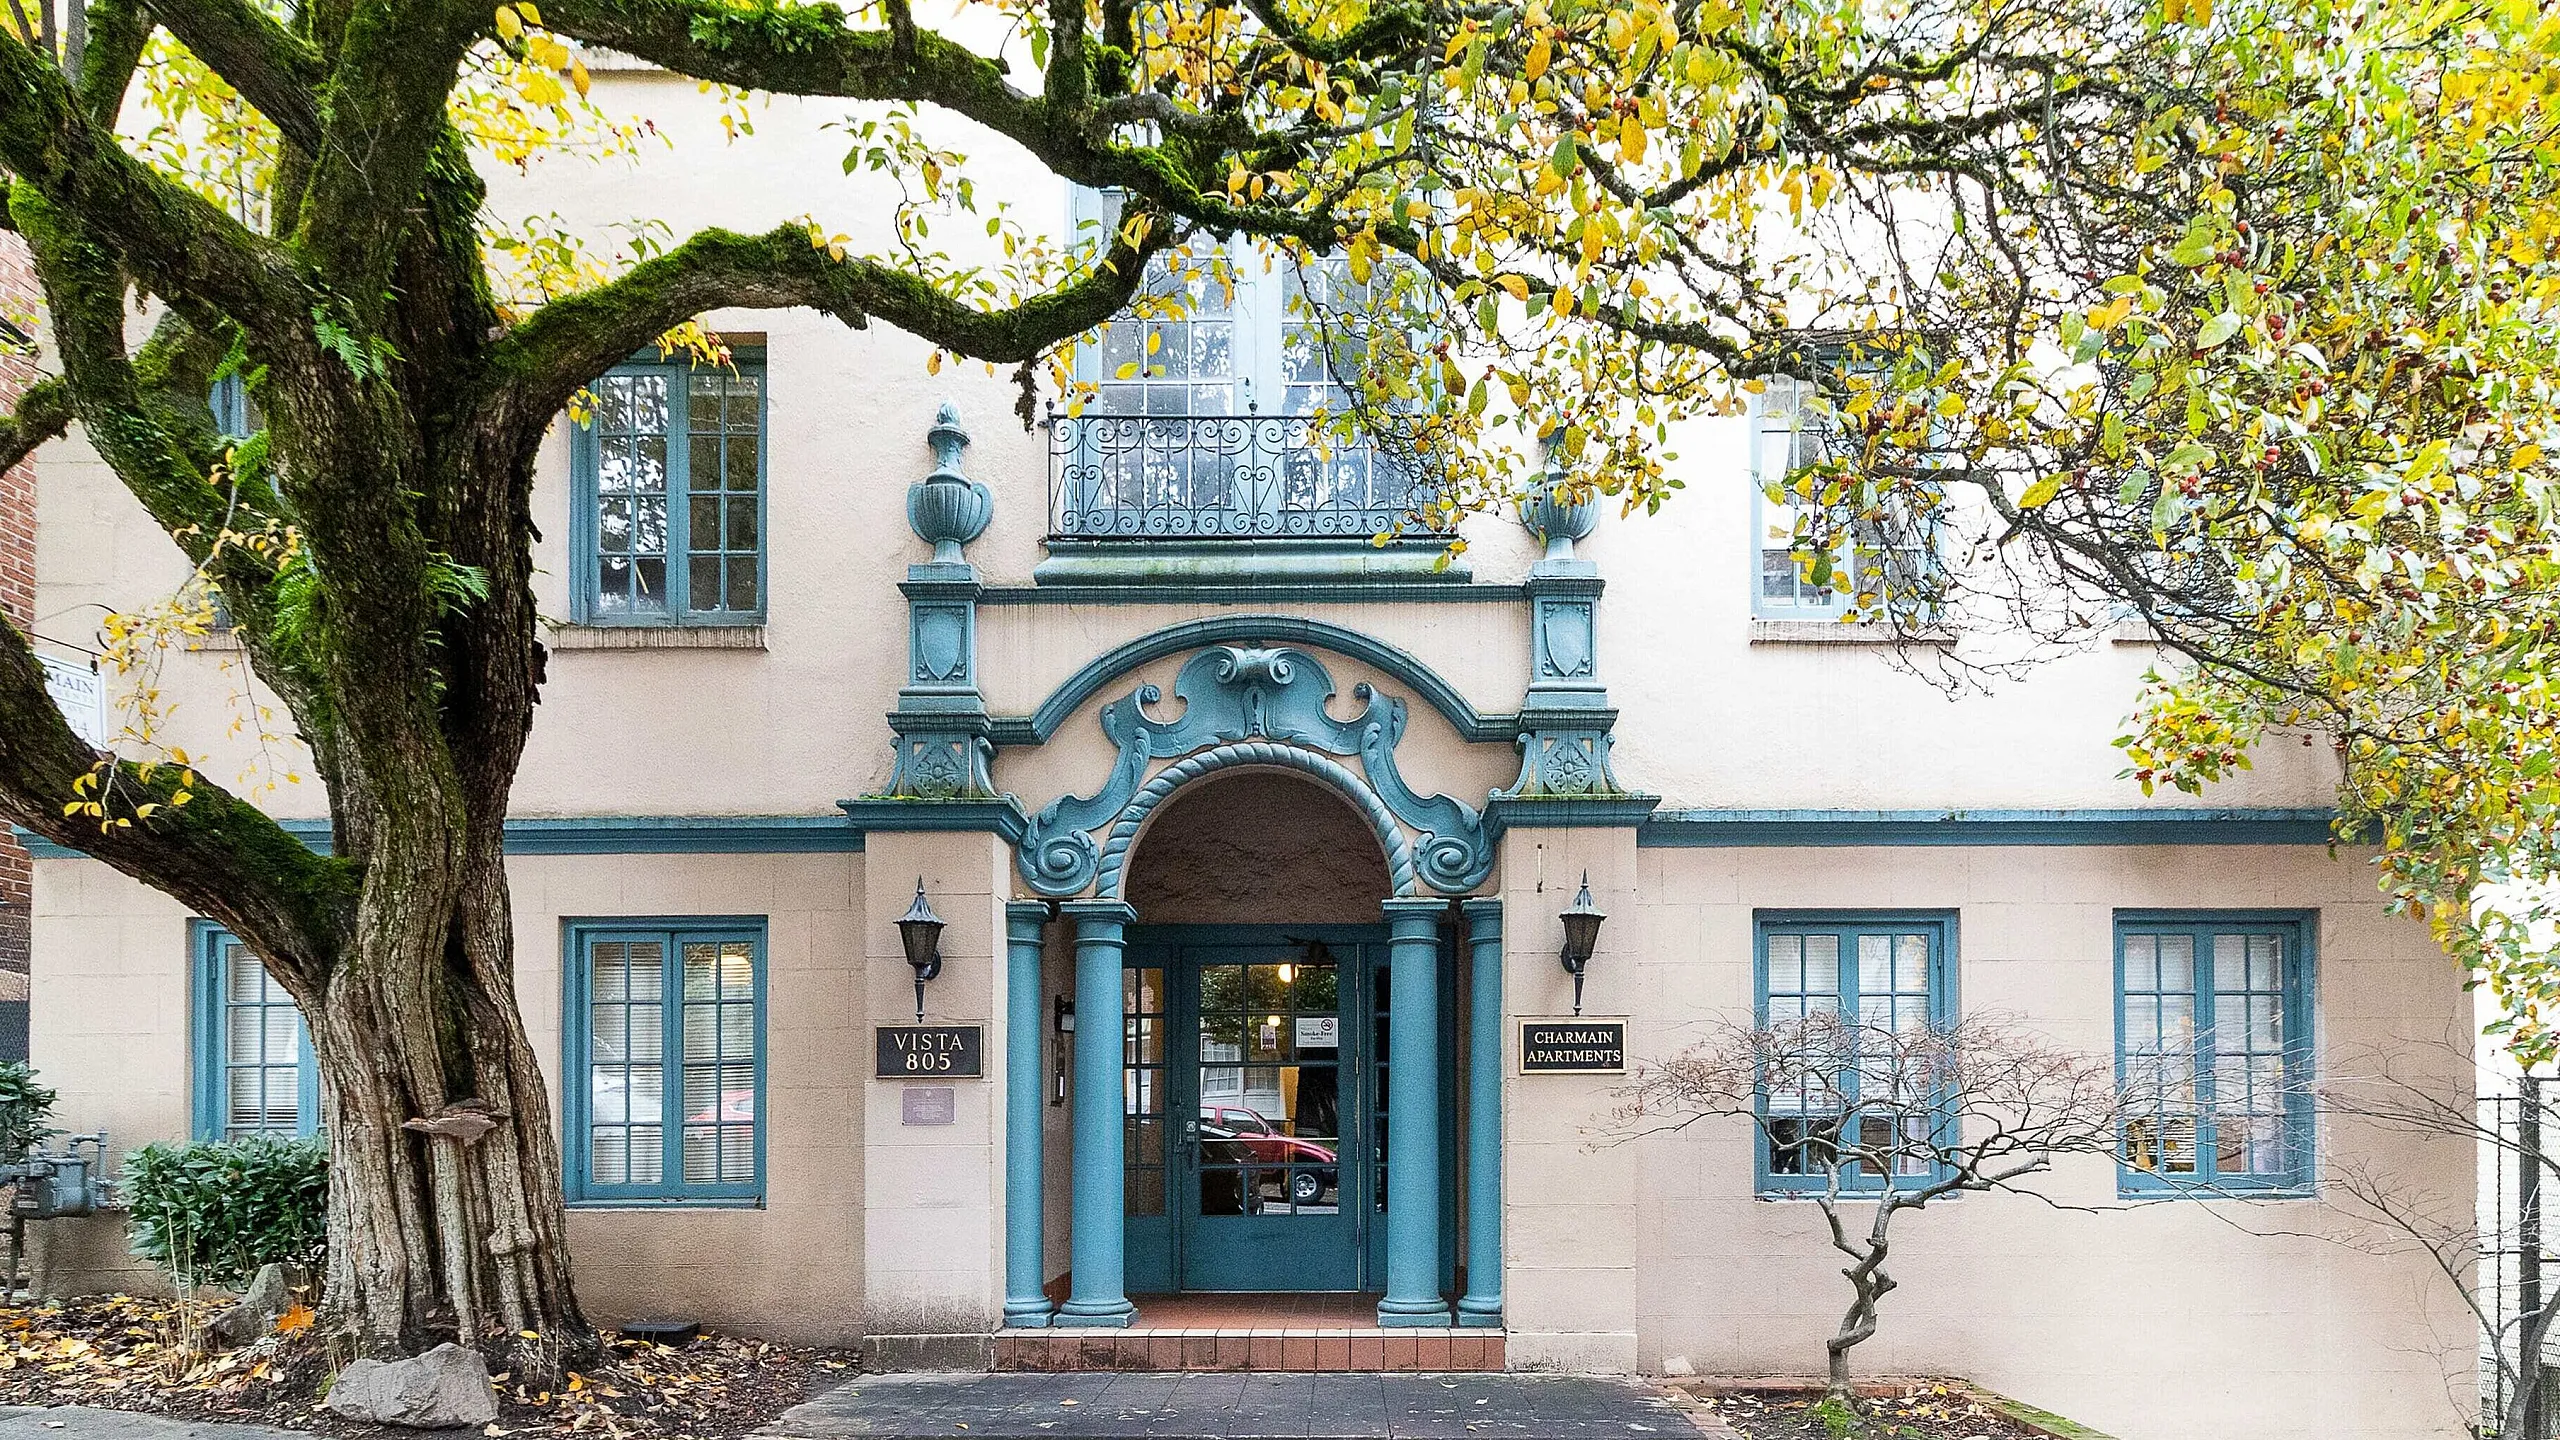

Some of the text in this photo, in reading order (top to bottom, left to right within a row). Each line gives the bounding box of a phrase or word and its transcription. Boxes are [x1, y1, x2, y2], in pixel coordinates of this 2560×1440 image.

[893, 1033, 964, 1051] VISTA
[1534, 1031, 1614, 1044] CHARMAIN
[905, 1052, 951, 1071] 805
[1526, 1049, 1621, 1063] APARTMENTS
